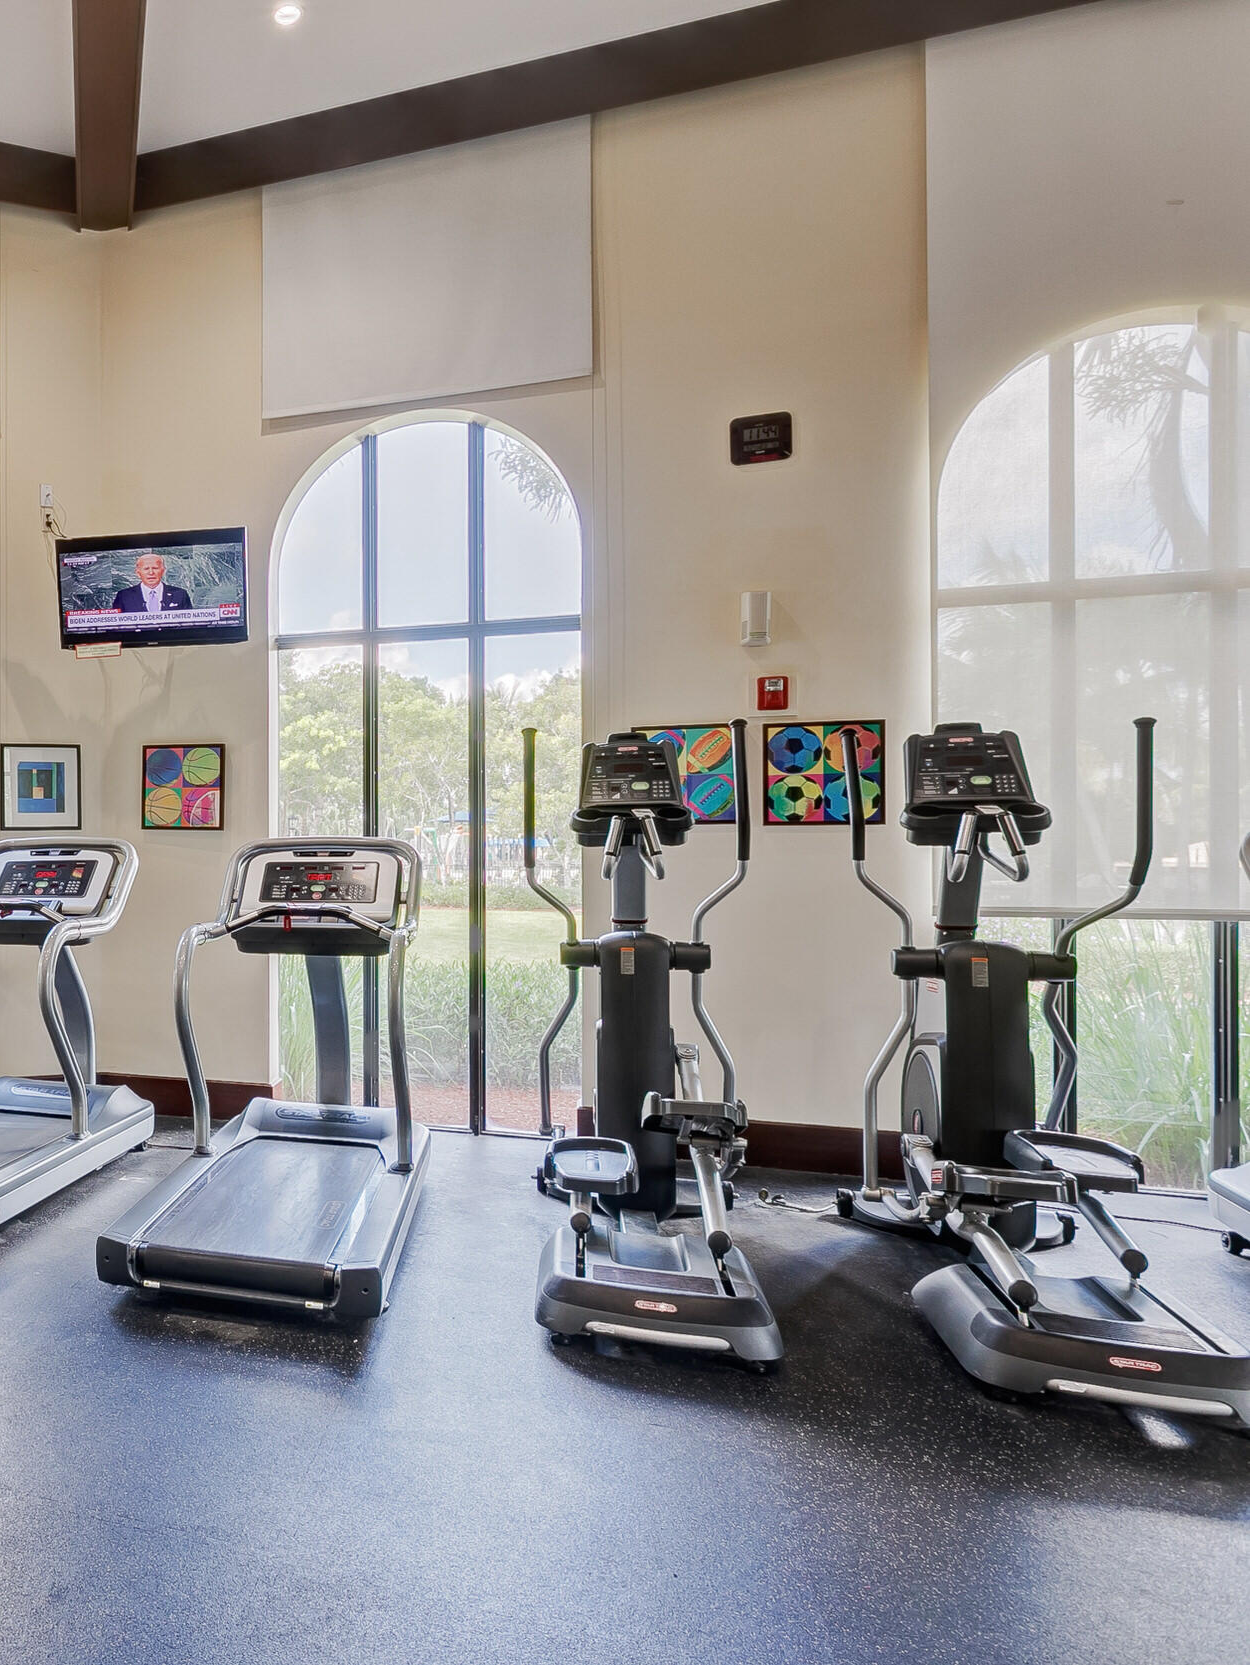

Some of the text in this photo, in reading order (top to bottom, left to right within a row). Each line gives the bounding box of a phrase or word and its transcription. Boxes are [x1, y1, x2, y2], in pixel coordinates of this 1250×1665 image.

[87, 615, 117, 623] ADDRESSES
[119, 614, 138, 622] WORLD
[139, 612, 163, 621] LEADERS
[1135, 1361, 1157, 1369] TRAC
